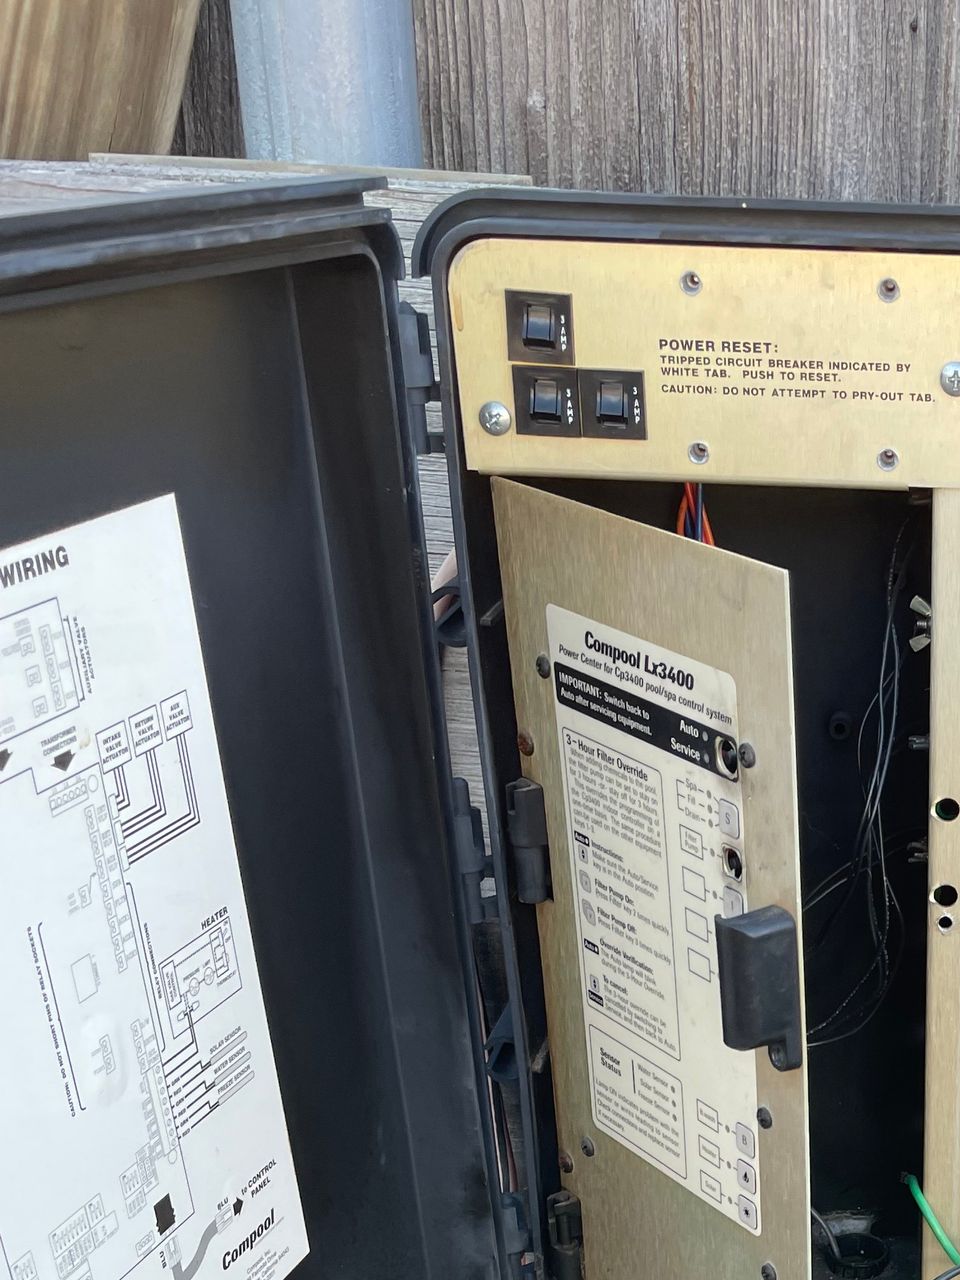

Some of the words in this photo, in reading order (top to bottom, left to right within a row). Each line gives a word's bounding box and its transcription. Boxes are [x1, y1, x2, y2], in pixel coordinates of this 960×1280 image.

[659, 339, 715, 352] POWER
[721, 341, 778, 352] RESET:
[660, 356, 711, 366] TRIPPED
[715, 357, 762, 368] CIRCUIT
[768, 359, 824, 370] BREAKER
[828, 361, 890, 372] INDICATED
[896, 363, 912, 372] BY
[661, 367, 699, 378] WHITE
[704, 368, 731, 378] TAB.
[742, 370, 774, 380] PUSH
[780, 372, 795, 380] TO
[800, 372, 842, 382] RESET.
[661, 384, 718, 395] CAUTION:
[722, 386, 739, 396] DO
[742, 387, 766, 397] NOT
[772, 388, 826, 399] ATTEMPT
[832, 390, 847, 400] TO
[852, 391, 904, 402] PRY-OUT
[909, 392, 936, 402] TAB.
[0, 545, 70, 588] WIRING
[585, 630, 640, 670] Compool
[644, 654, 694, 691] Lx3400
[558, 644, 579, 660] Power
[580, 652, 602, 671] Center
[604, 661, 614, 675] for
[614, 667, 644, 688] Cp3400
[646, 681, 676, 704] pool/spa
[678, 695, 704, 714] control
[706, 708, 732, 726] system
[559, 672, 602, 700] IMPORTANT:
[604, 692, 626, 710] Switch
[626, 700, 642, 717] back
[642, 709, 650, 720] to
[560, 686, 574, 702] Auto
[576, 694, 590, 708] after
[590, 702, 616, 723] servicing
[618, 713, 652, 736] equipment.
[680, 719, 699, 739] Auto
[670, 737, 701, 762] Service
[596, 748, 614, 766] Filter
[616, 758, 648, 782] Override
[201, 906, 228, 930] HEATER
[600, 1048, 620, 1066] Sensor
[600, 1057, 622, 1077] Status
[248, 1158, 276, 1188] CONTROL
[251, 1176, 271, 1198] PANEL
[222, 1207, 274, 1271] Compool
